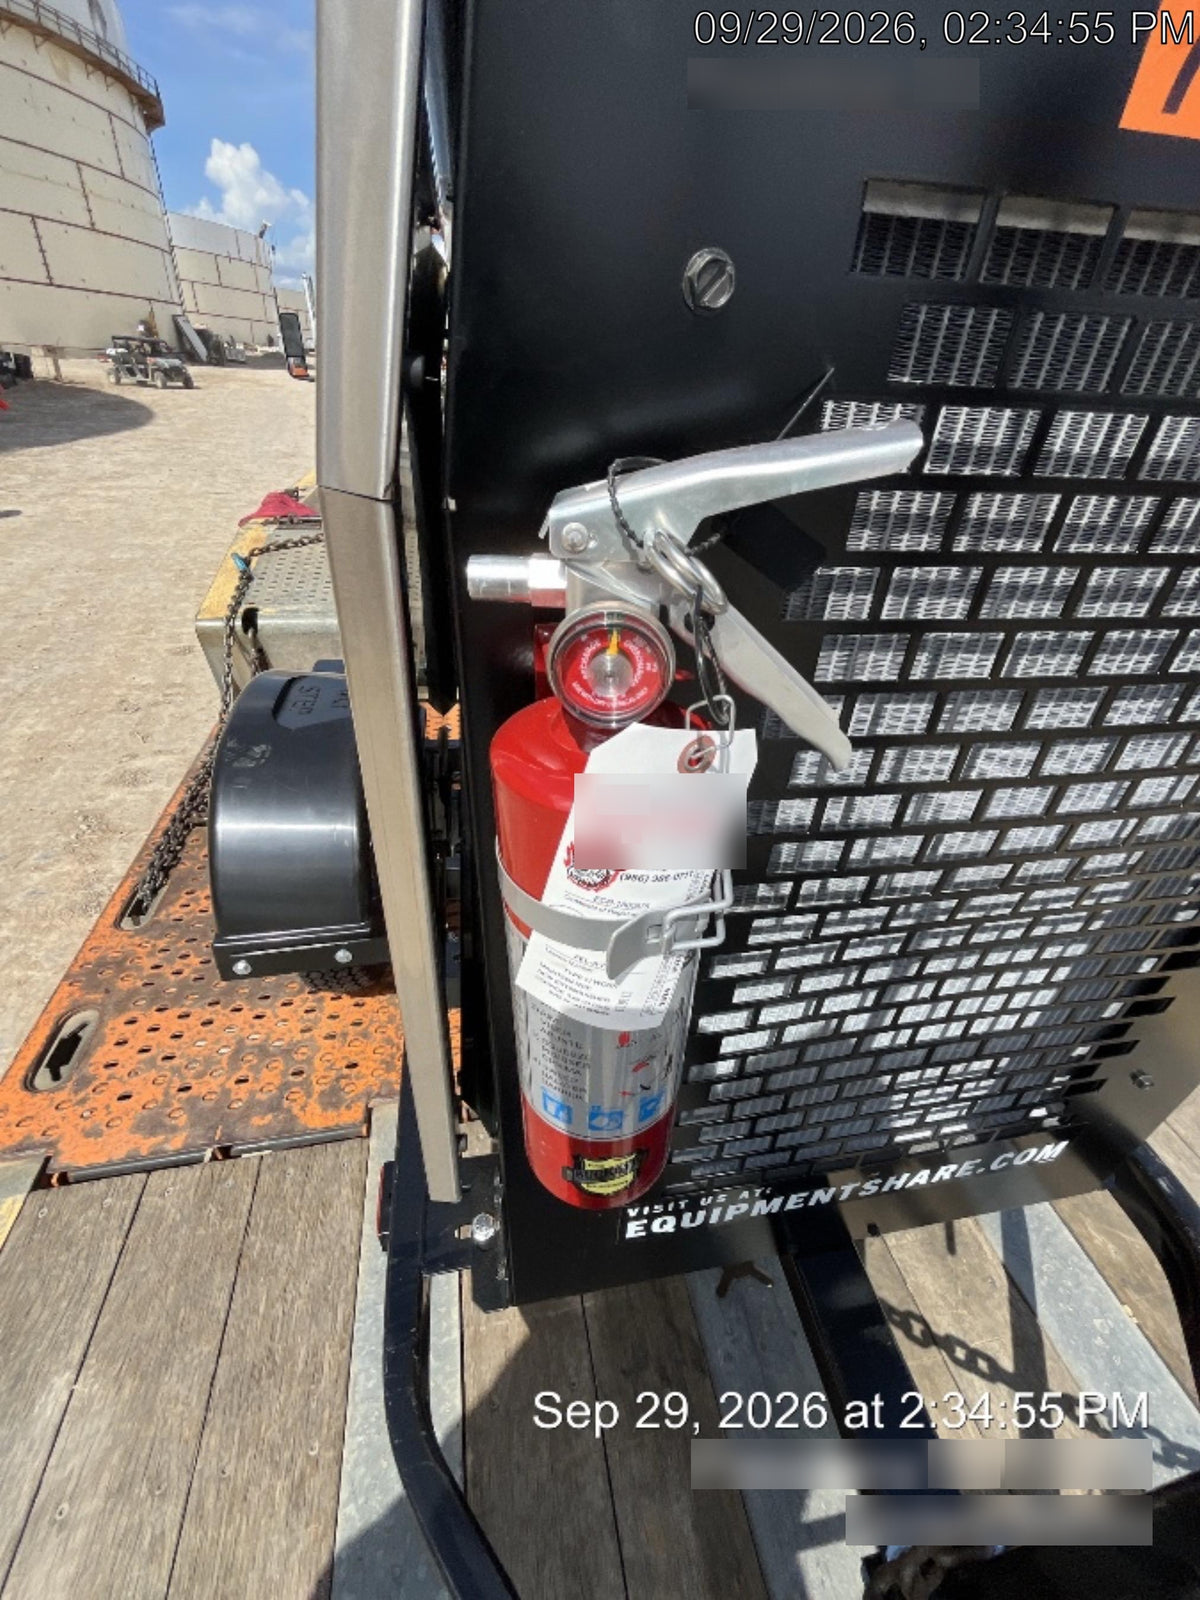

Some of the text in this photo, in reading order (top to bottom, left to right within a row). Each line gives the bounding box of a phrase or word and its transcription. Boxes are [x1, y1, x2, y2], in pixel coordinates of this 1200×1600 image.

[625, 1139, 1070, 1240] EQUIPMENTSHARE.COM
[626, 1199, 689, 1217] VISIT
[700, 1193, 728, 1206] US
